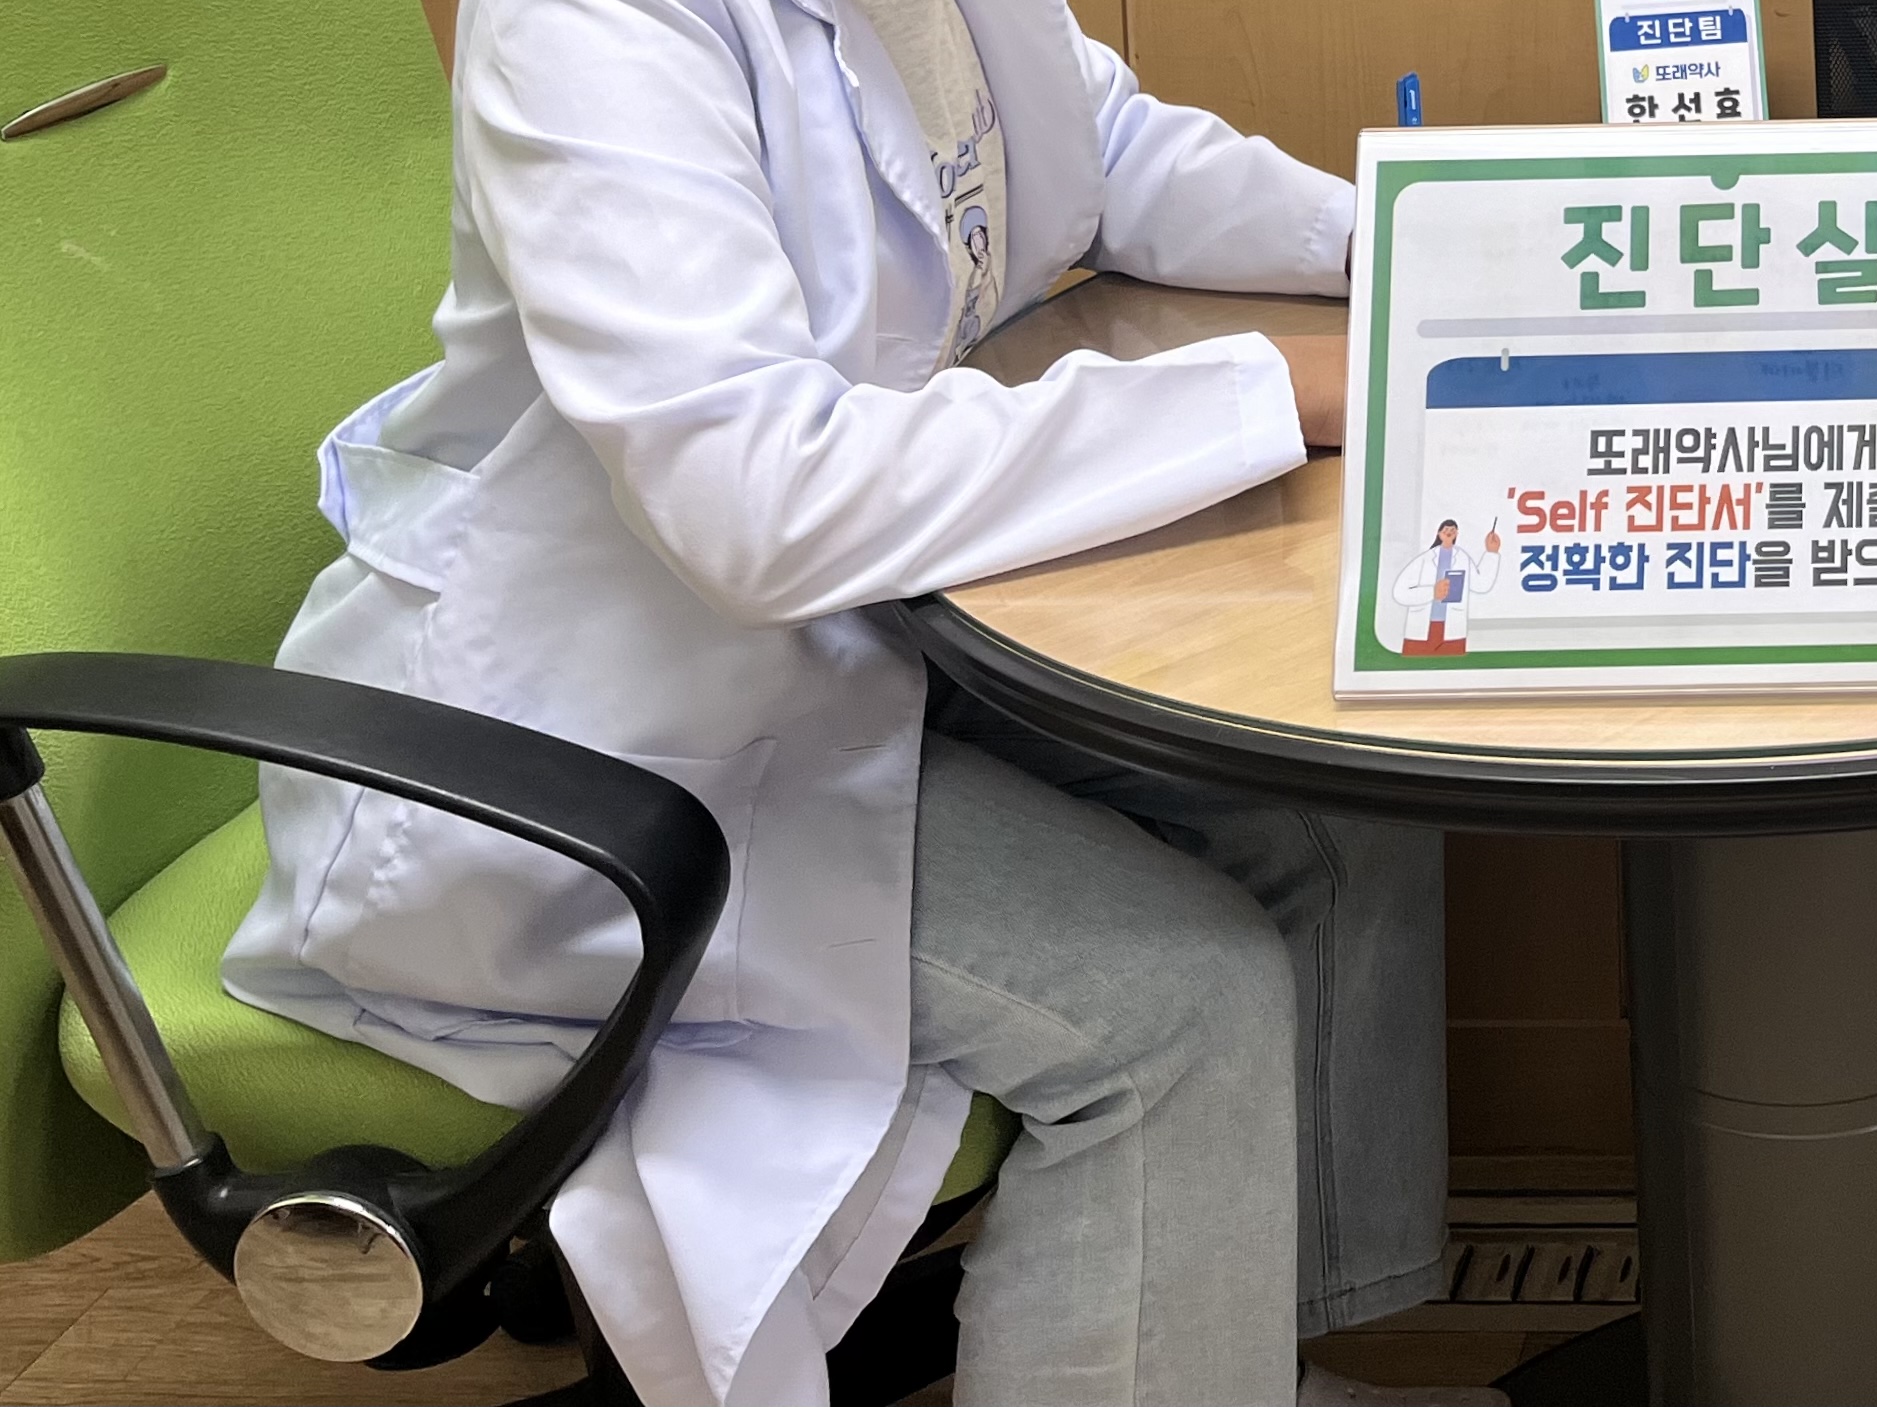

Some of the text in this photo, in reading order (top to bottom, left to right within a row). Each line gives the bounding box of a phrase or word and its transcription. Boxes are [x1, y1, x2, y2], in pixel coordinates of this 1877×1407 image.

[1636, 15, 1723, 45] 진단팀
[1655, 61, 1721, 81] 또래약사
[1520, 542, 1650, 591] 정확한
[1665, 540, 1794, 590] 진단을
